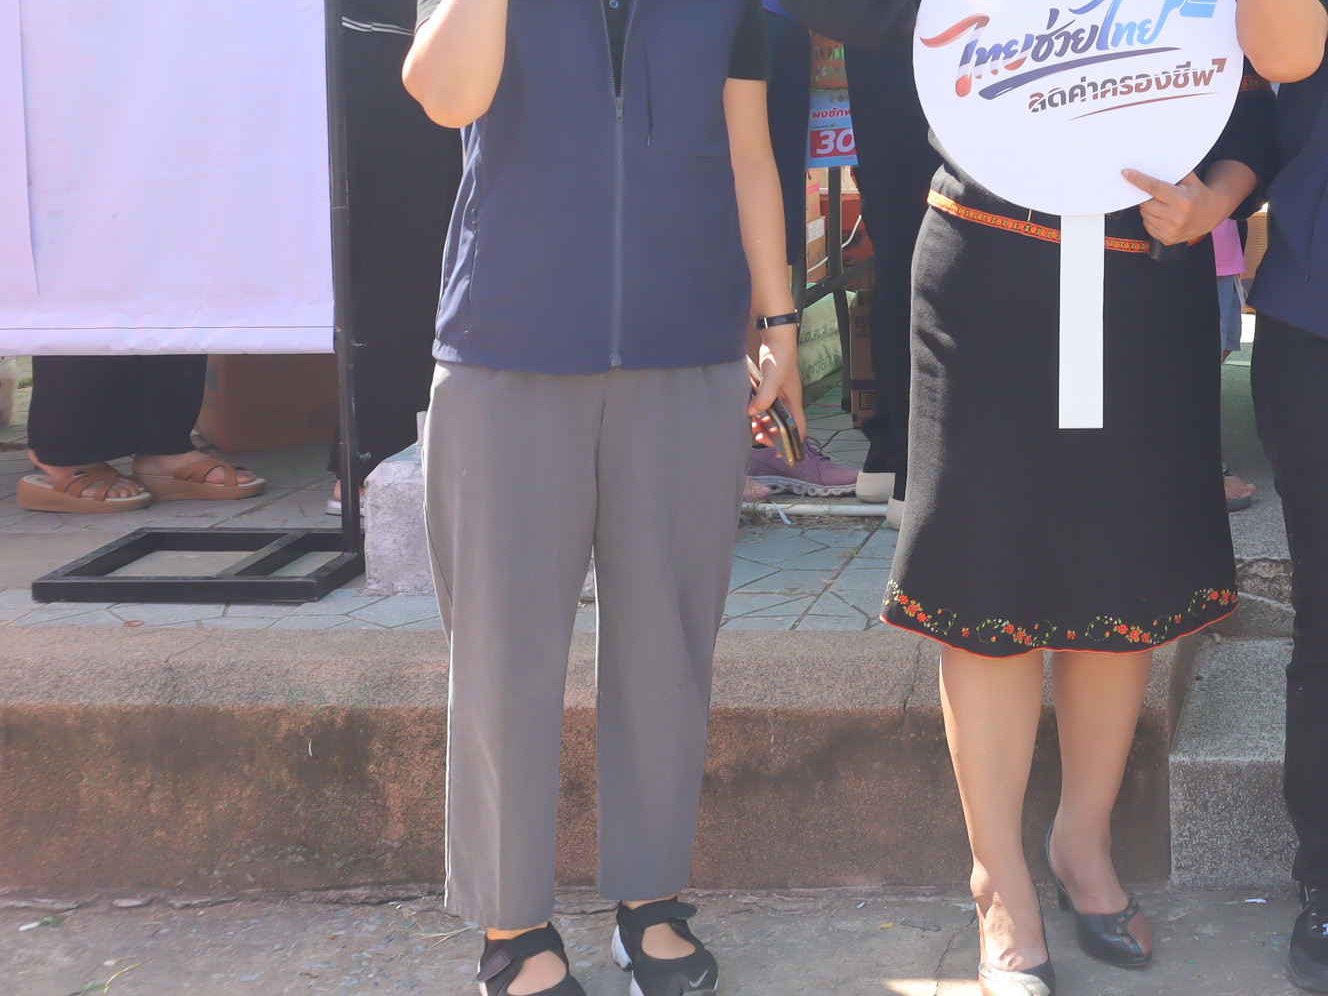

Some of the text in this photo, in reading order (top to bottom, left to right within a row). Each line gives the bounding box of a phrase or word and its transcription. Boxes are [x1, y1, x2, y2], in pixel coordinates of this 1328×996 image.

[1028, 59, 1218, 113] ลดค่าครองชีพ
[816, 129, 856, 155] 30
